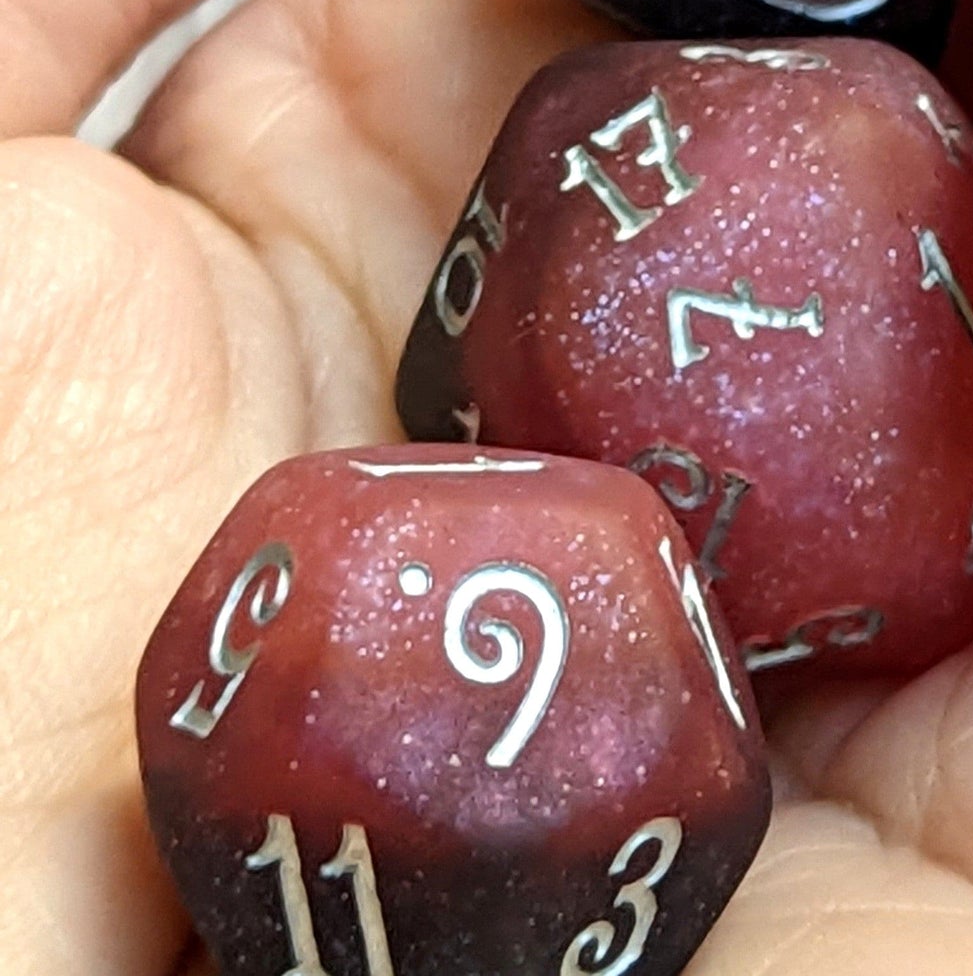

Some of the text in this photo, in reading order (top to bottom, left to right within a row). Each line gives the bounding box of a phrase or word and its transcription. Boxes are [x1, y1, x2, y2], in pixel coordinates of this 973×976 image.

[560, 87, 701, 241] 17
[667, 278, 823, 368] 7
[170, 542, 294, 738] 5
[245, 814, 394, 976] 11
[561, 817, 683, 976] 3
